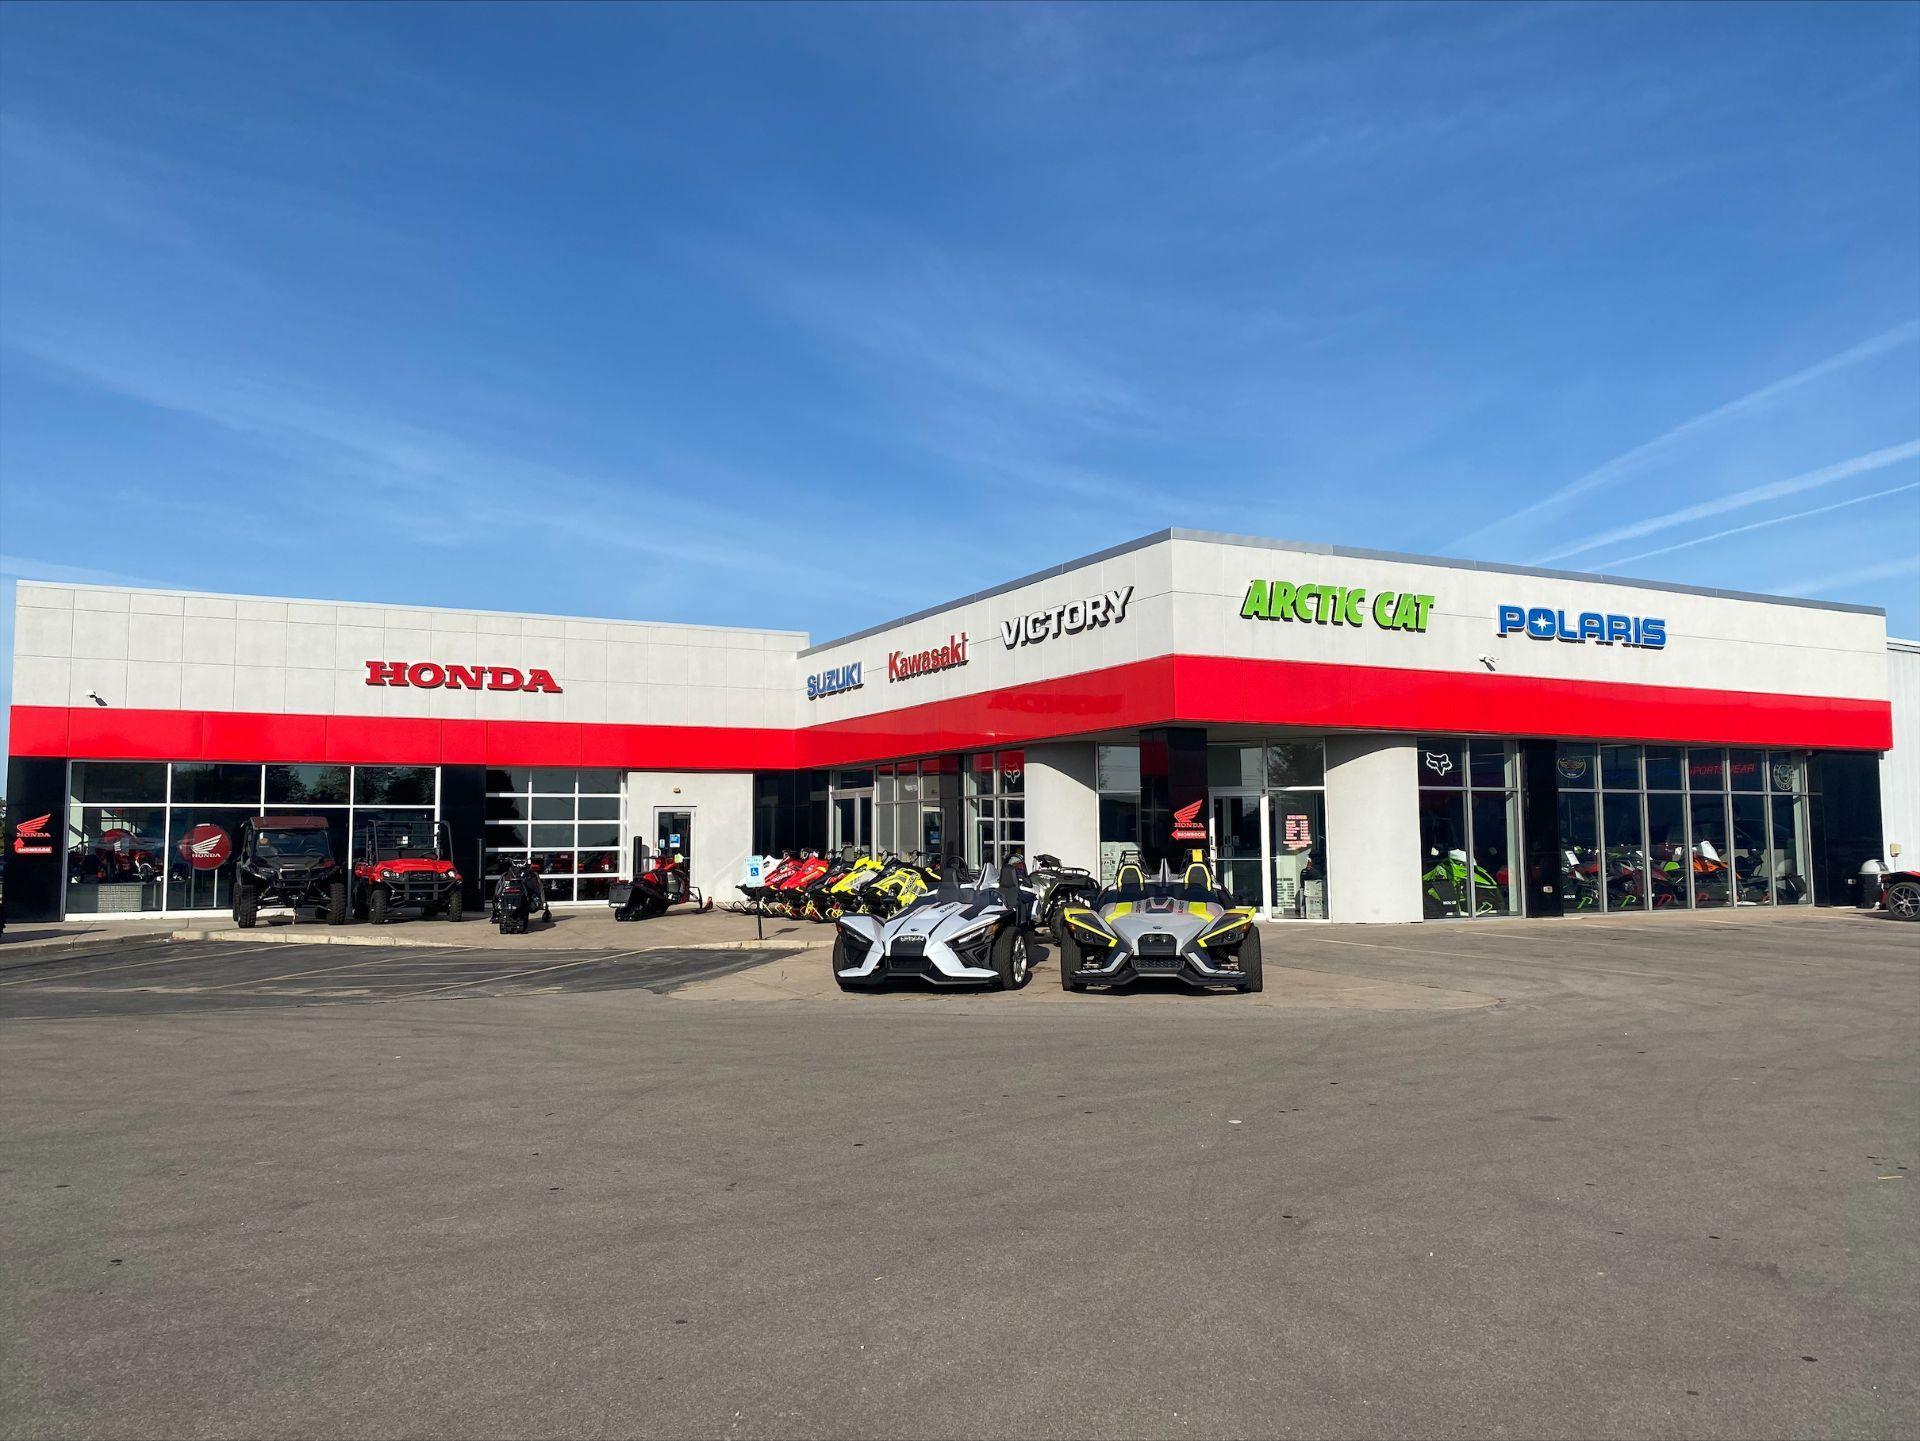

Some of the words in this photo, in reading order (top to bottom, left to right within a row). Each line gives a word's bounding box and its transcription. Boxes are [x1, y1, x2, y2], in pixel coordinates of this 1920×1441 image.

[1000, 585, 1134, 650] VICTORY
[1240, 579, 1366, 628] ARCTIC
[1373, 591, 1435, 633] CAT
[1496, 604, 1667, 650] POLARIS
[366, 661, 563, 693] HONDA
[807, 661, 864, 700] SUZUKI
[888, 632, 969, 682] Kawasaki
